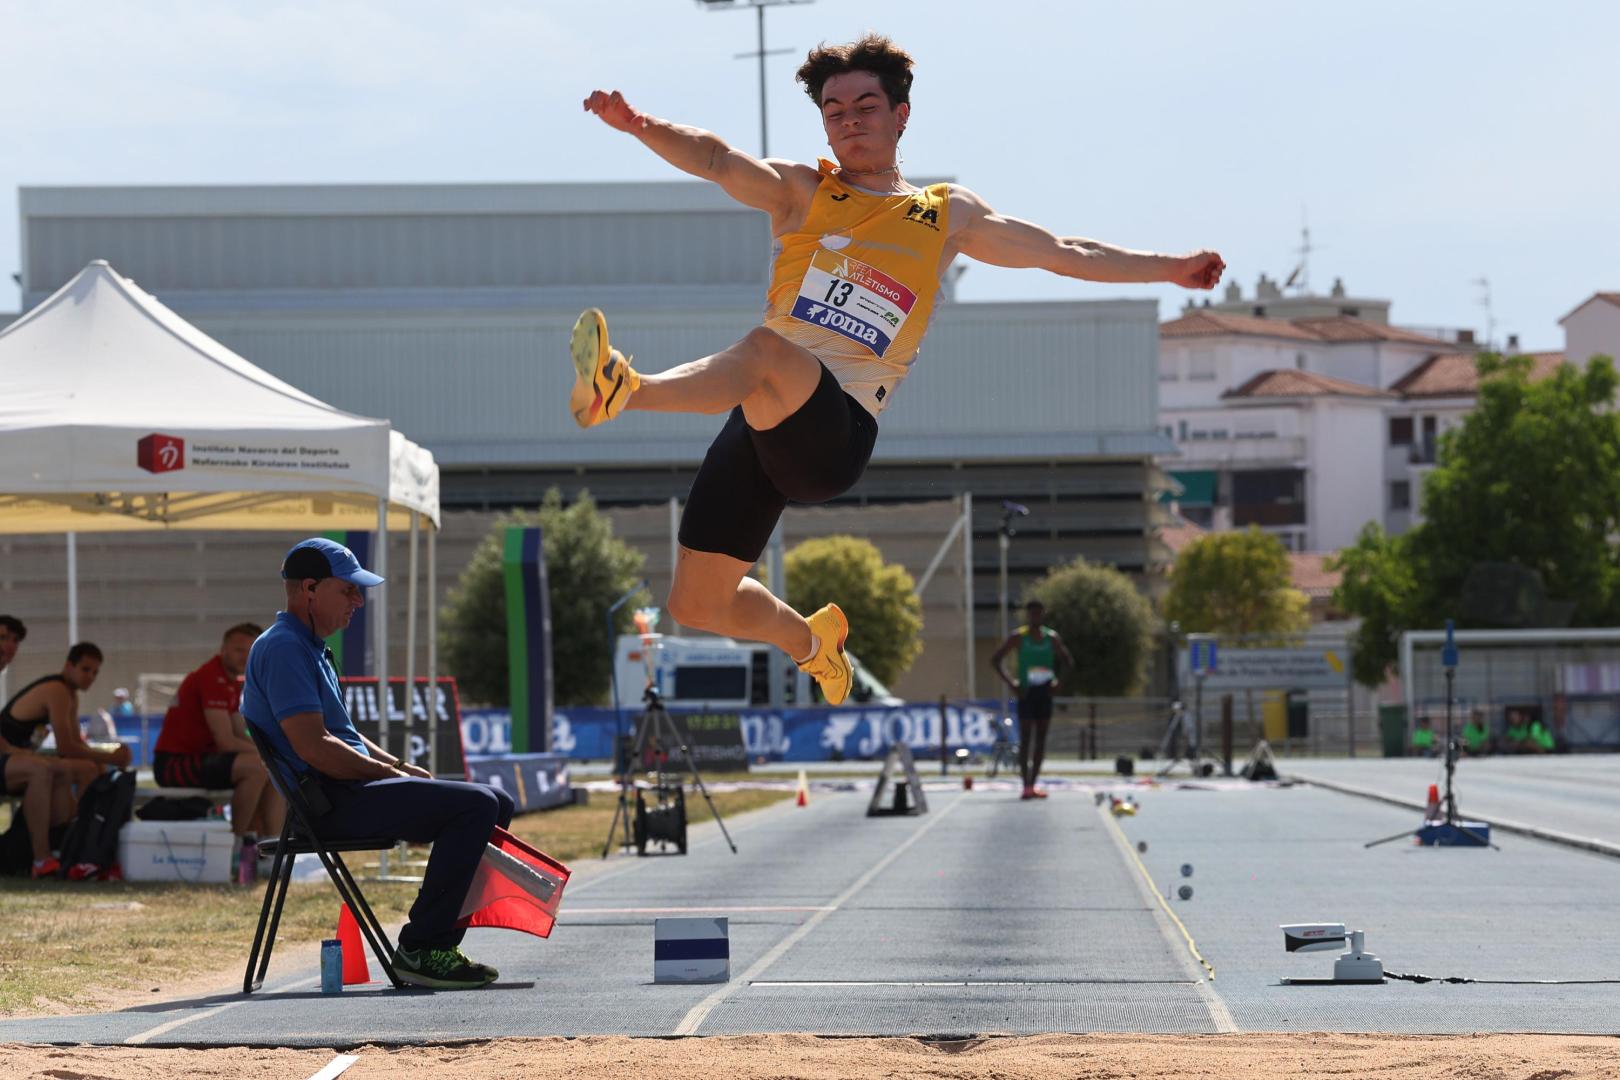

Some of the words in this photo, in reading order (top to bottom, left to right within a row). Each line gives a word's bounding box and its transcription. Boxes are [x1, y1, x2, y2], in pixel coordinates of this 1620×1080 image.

[907, 203, 938, 224] PA
[824, 278, 854, 307] 13
[848, 271, 901, 301] ATLETISMO
[238, 446, 279, 455] Navarro
[281, 447, 297, 455] del
[299, 448, 339, 457] Deporte
